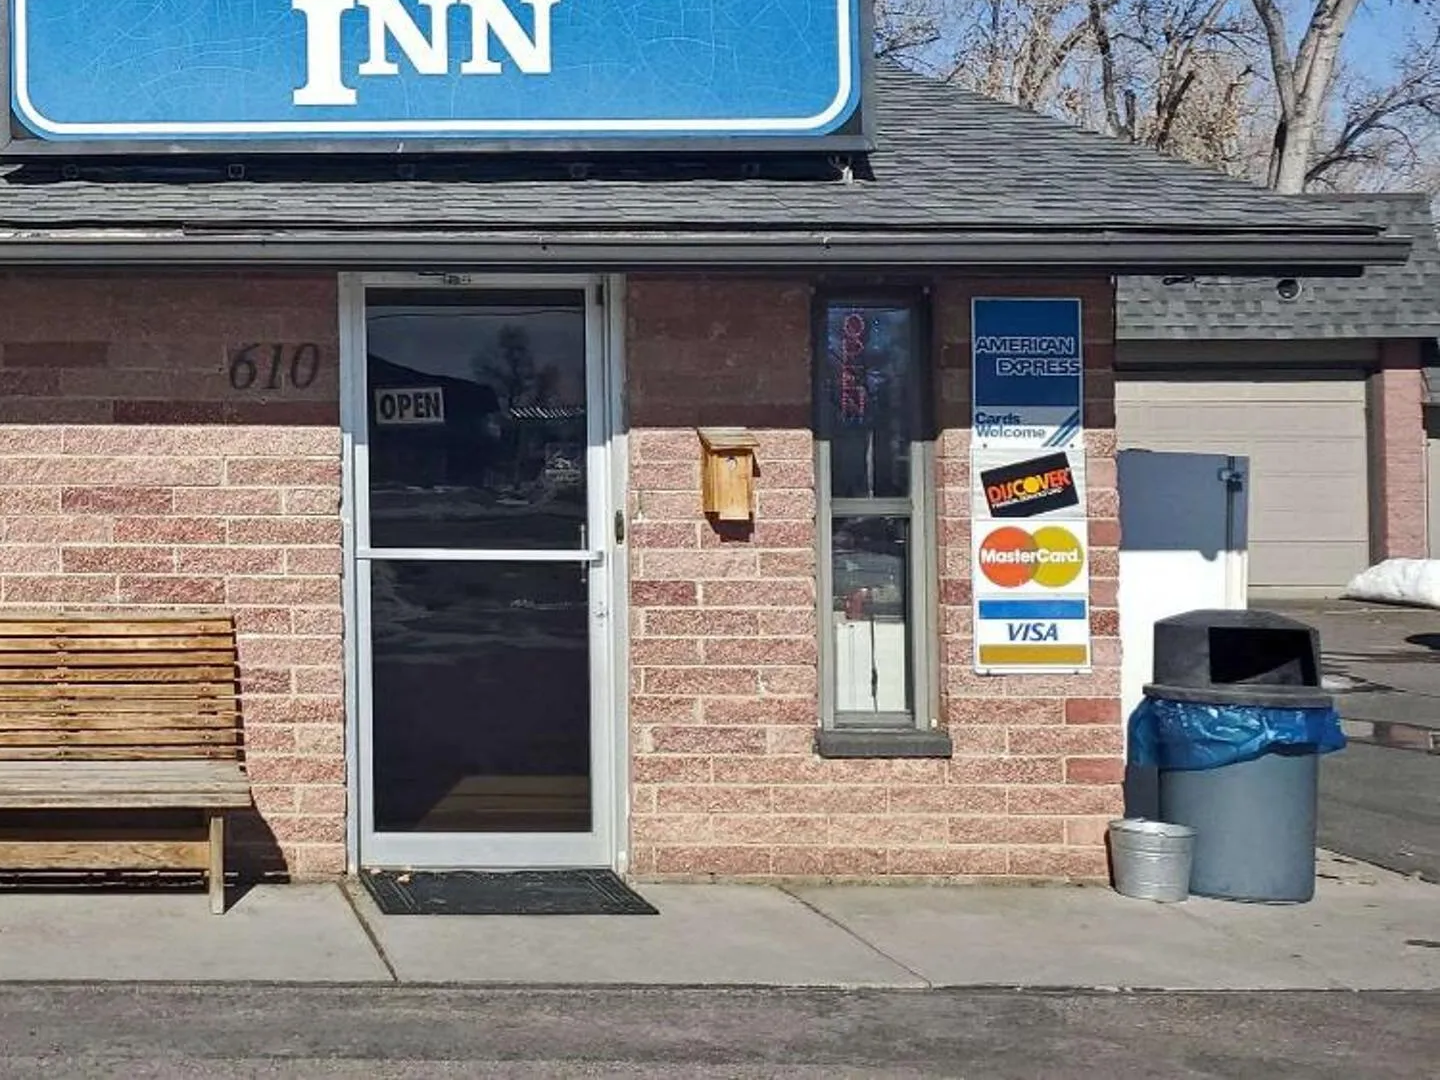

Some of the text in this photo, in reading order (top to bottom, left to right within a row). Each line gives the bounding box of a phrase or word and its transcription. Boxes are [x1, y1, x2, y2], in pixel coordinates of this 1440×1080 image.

[975, 336, 1074, 355] AMERICAN
[229, 343, 320, 390] 610
[996, 357, 1080, 376] EXPRESS
[379, 391, 442, 420] OPEN
[975, 412, 1022, 425] Cards
[975, 424, 1046, 439] Welcome
[987, 470, 1071, 503] DISCOVER
[980, 548, 1078, 564] MasterCard
[1007, 623, 1059, 642] VISA
